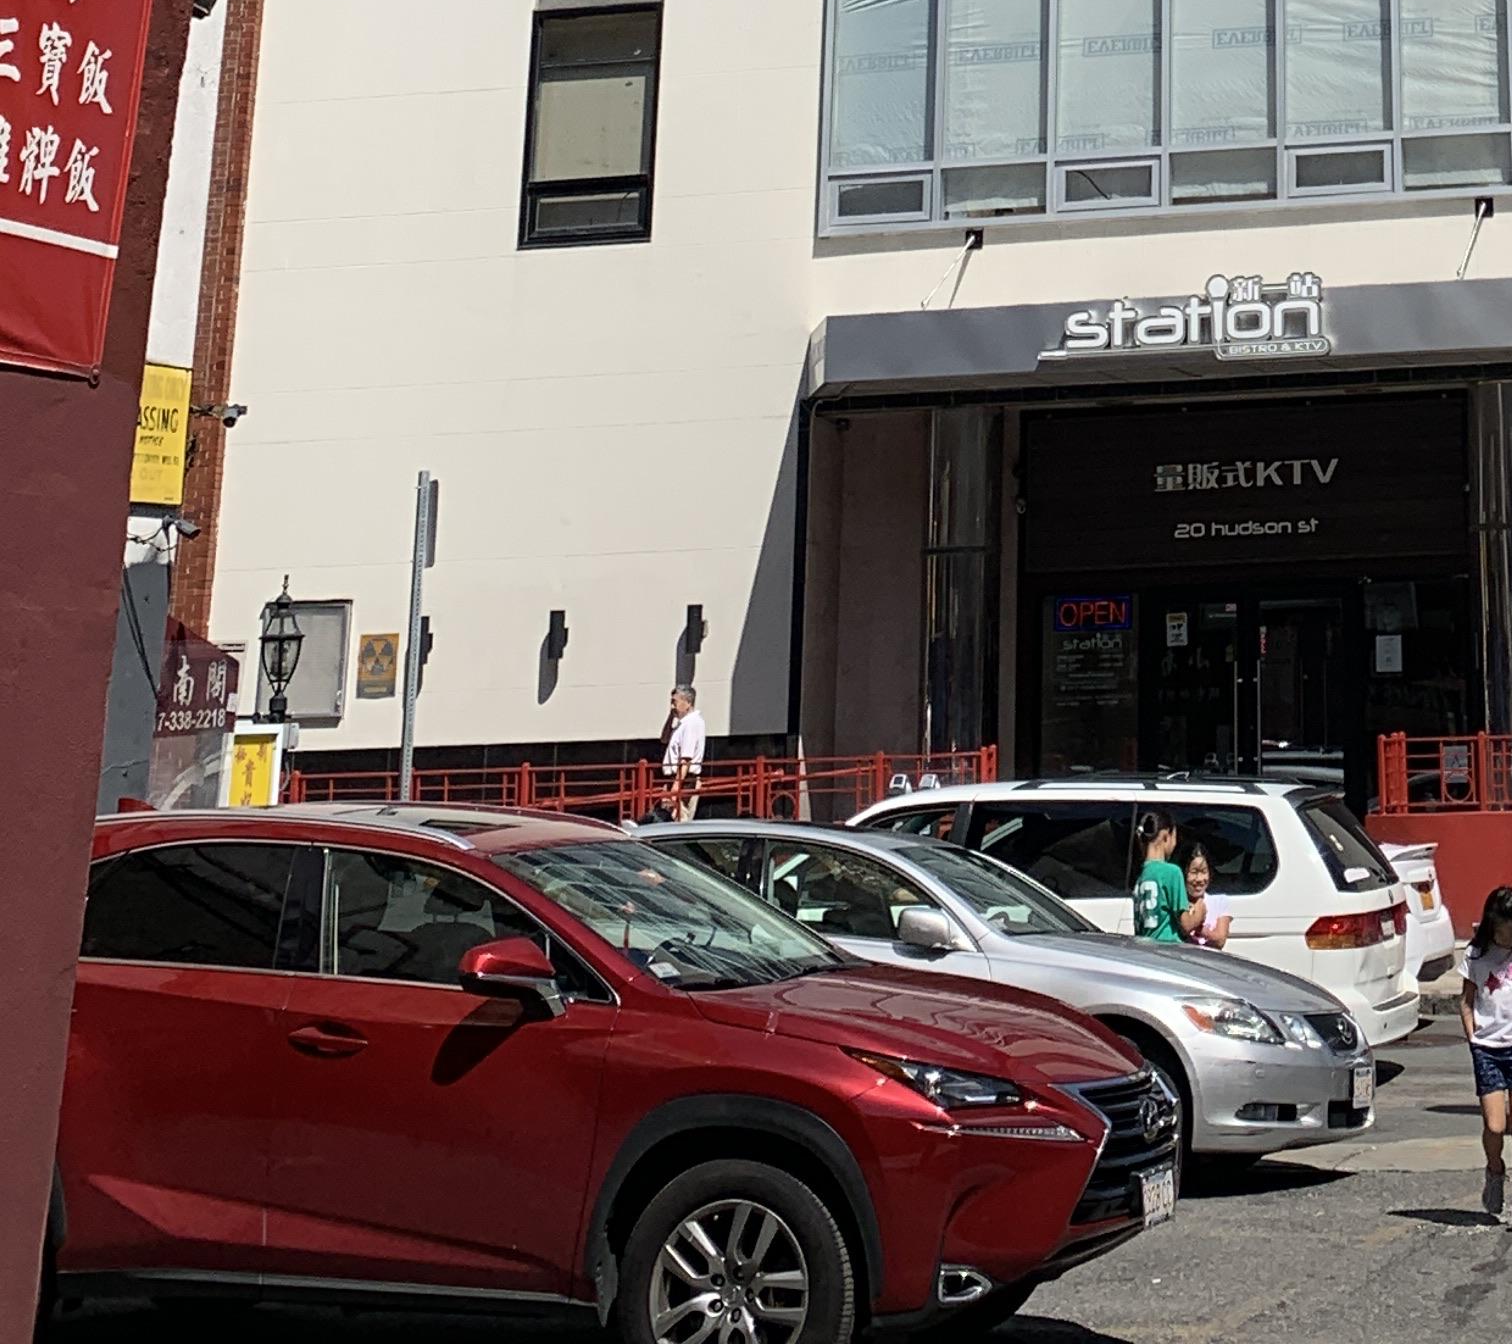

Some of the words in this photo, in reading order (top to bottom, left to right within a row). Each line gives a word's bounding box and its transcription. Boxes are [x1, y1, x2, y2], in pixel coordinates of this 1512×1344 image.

[1065, 274, 1321, 348] station
[1229, 343, 1278, 354] BISTRO
[1294, 341, 1324, 352] KTV
[1174, 523, 1206, 538] 20
[1211, 520, 1292, 537] hudson
[1297, 517, 1319, 534] st
[1059, 600, 1126, 627] OPEN
